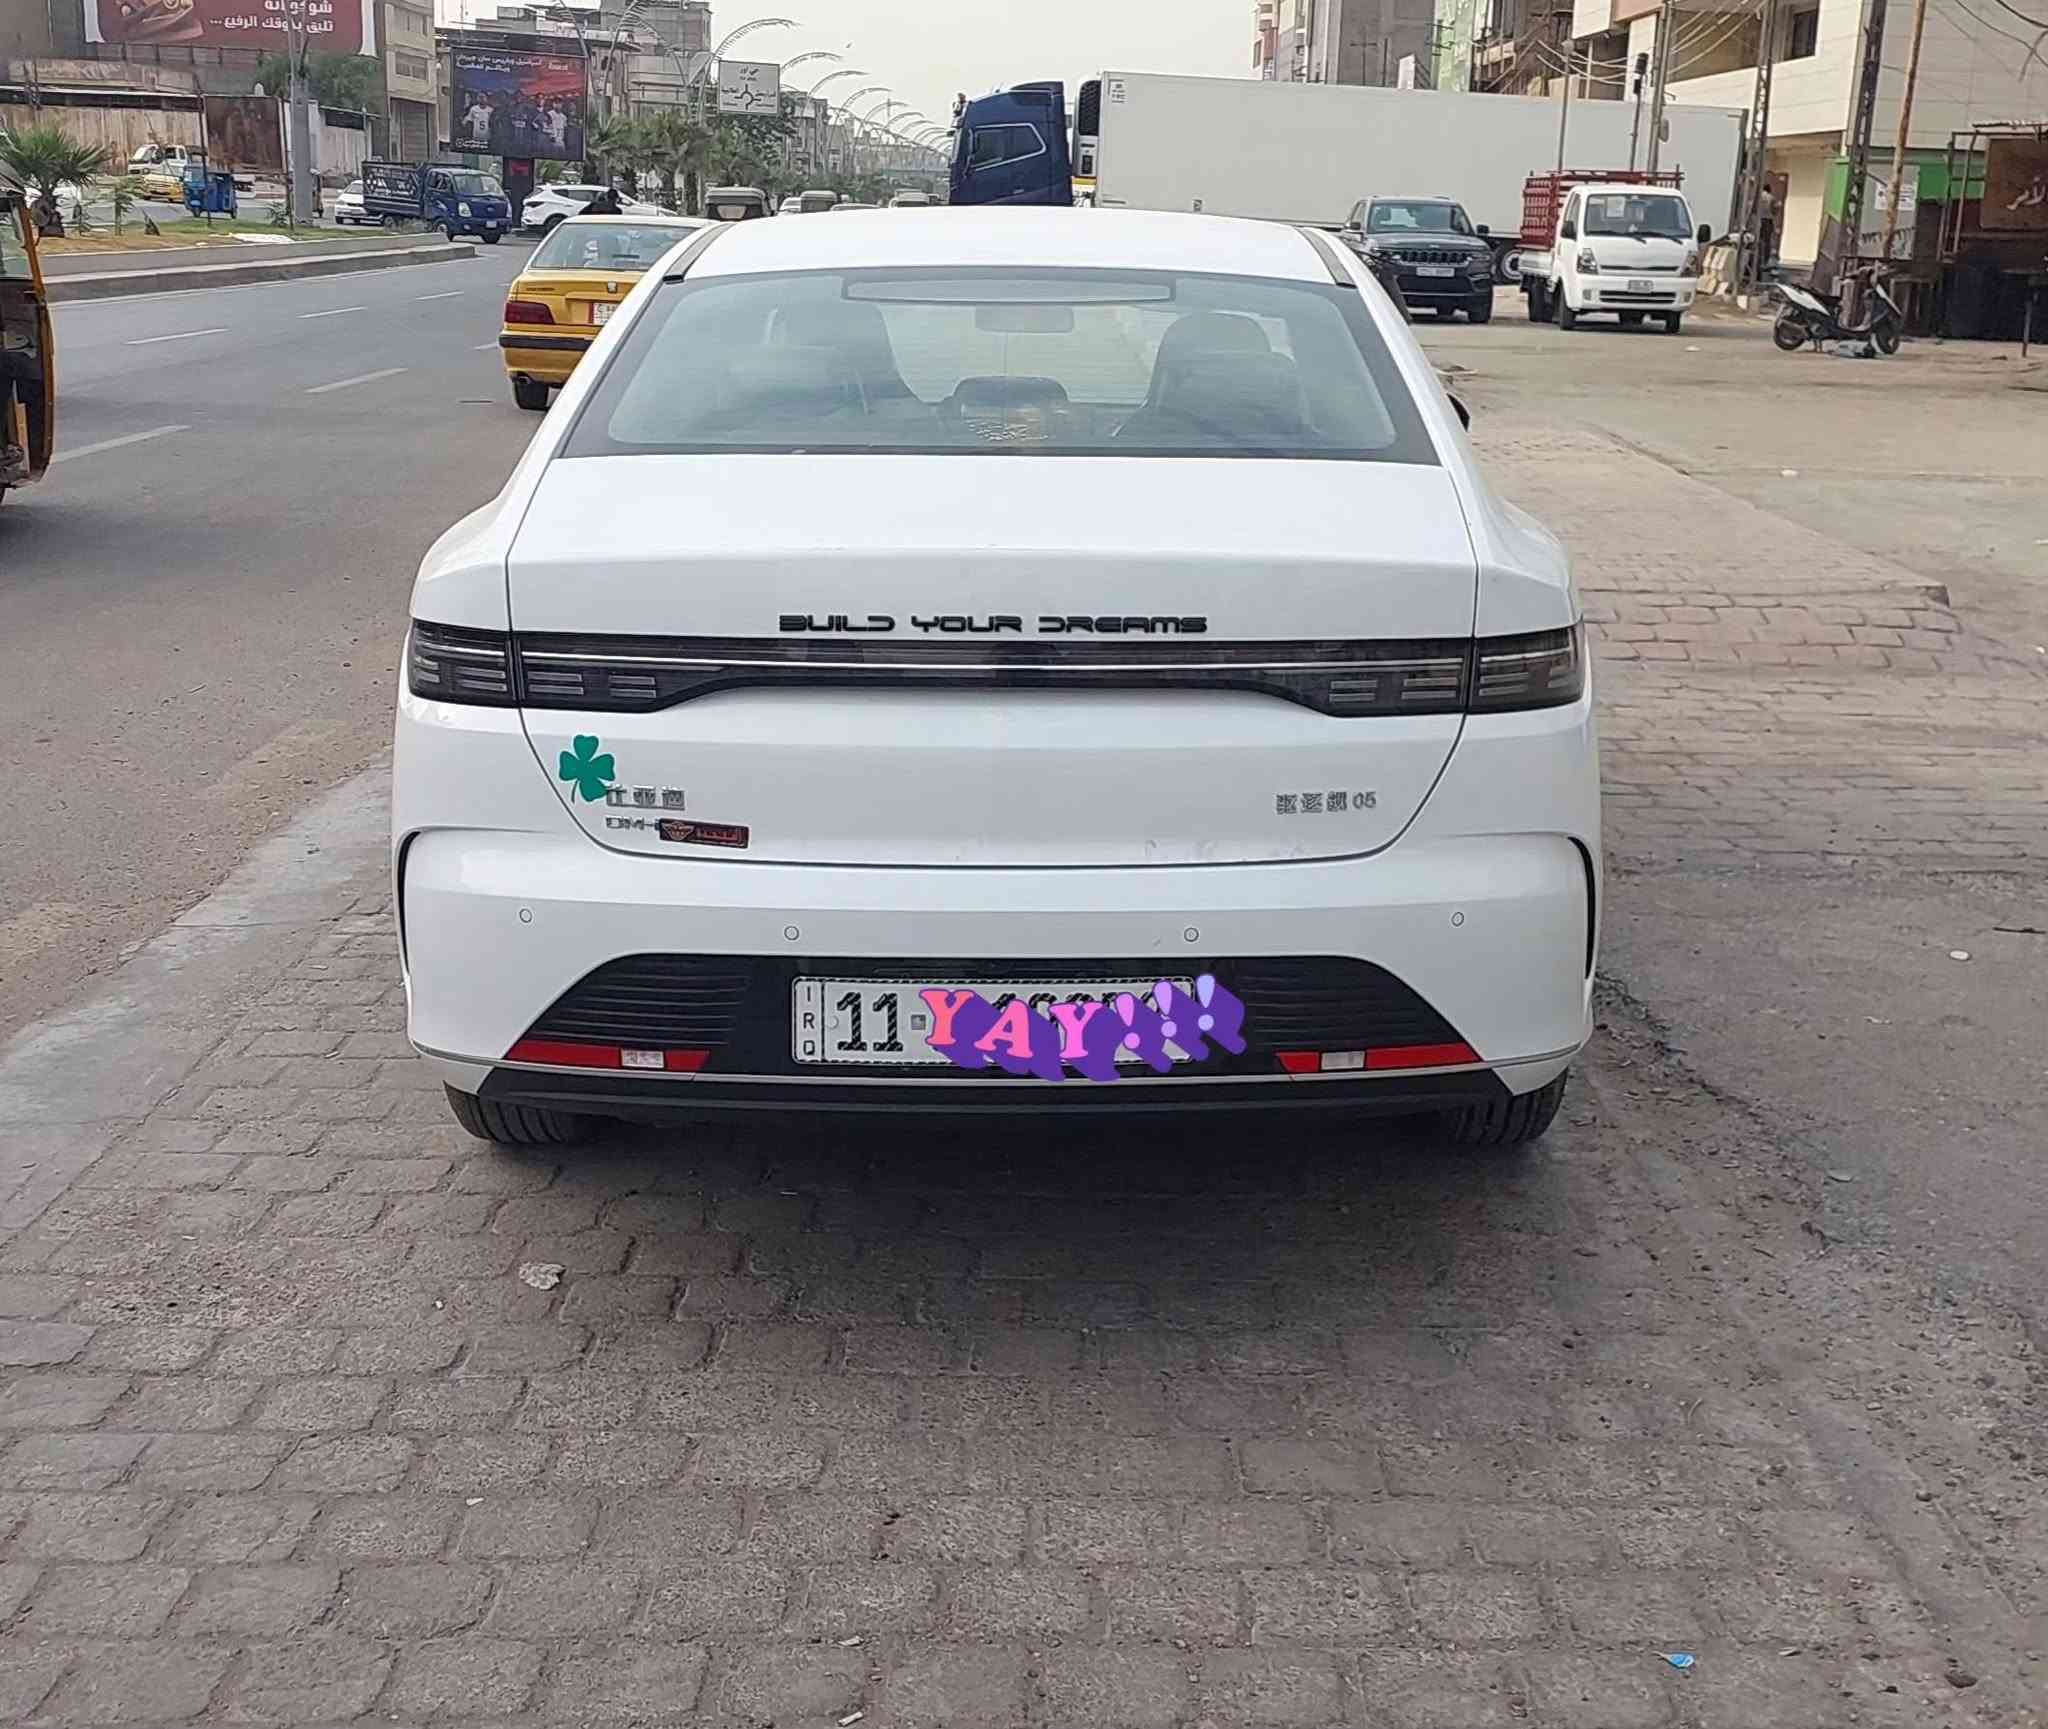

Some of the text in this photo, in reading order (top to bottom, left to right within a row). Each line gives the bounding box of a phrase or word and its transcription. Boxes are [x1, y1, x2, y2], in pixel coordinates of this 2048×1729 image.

[779, 615, 1208, 633] BUILD YOUR DREAMS
[803, 985, 816, 1056] IRQ
